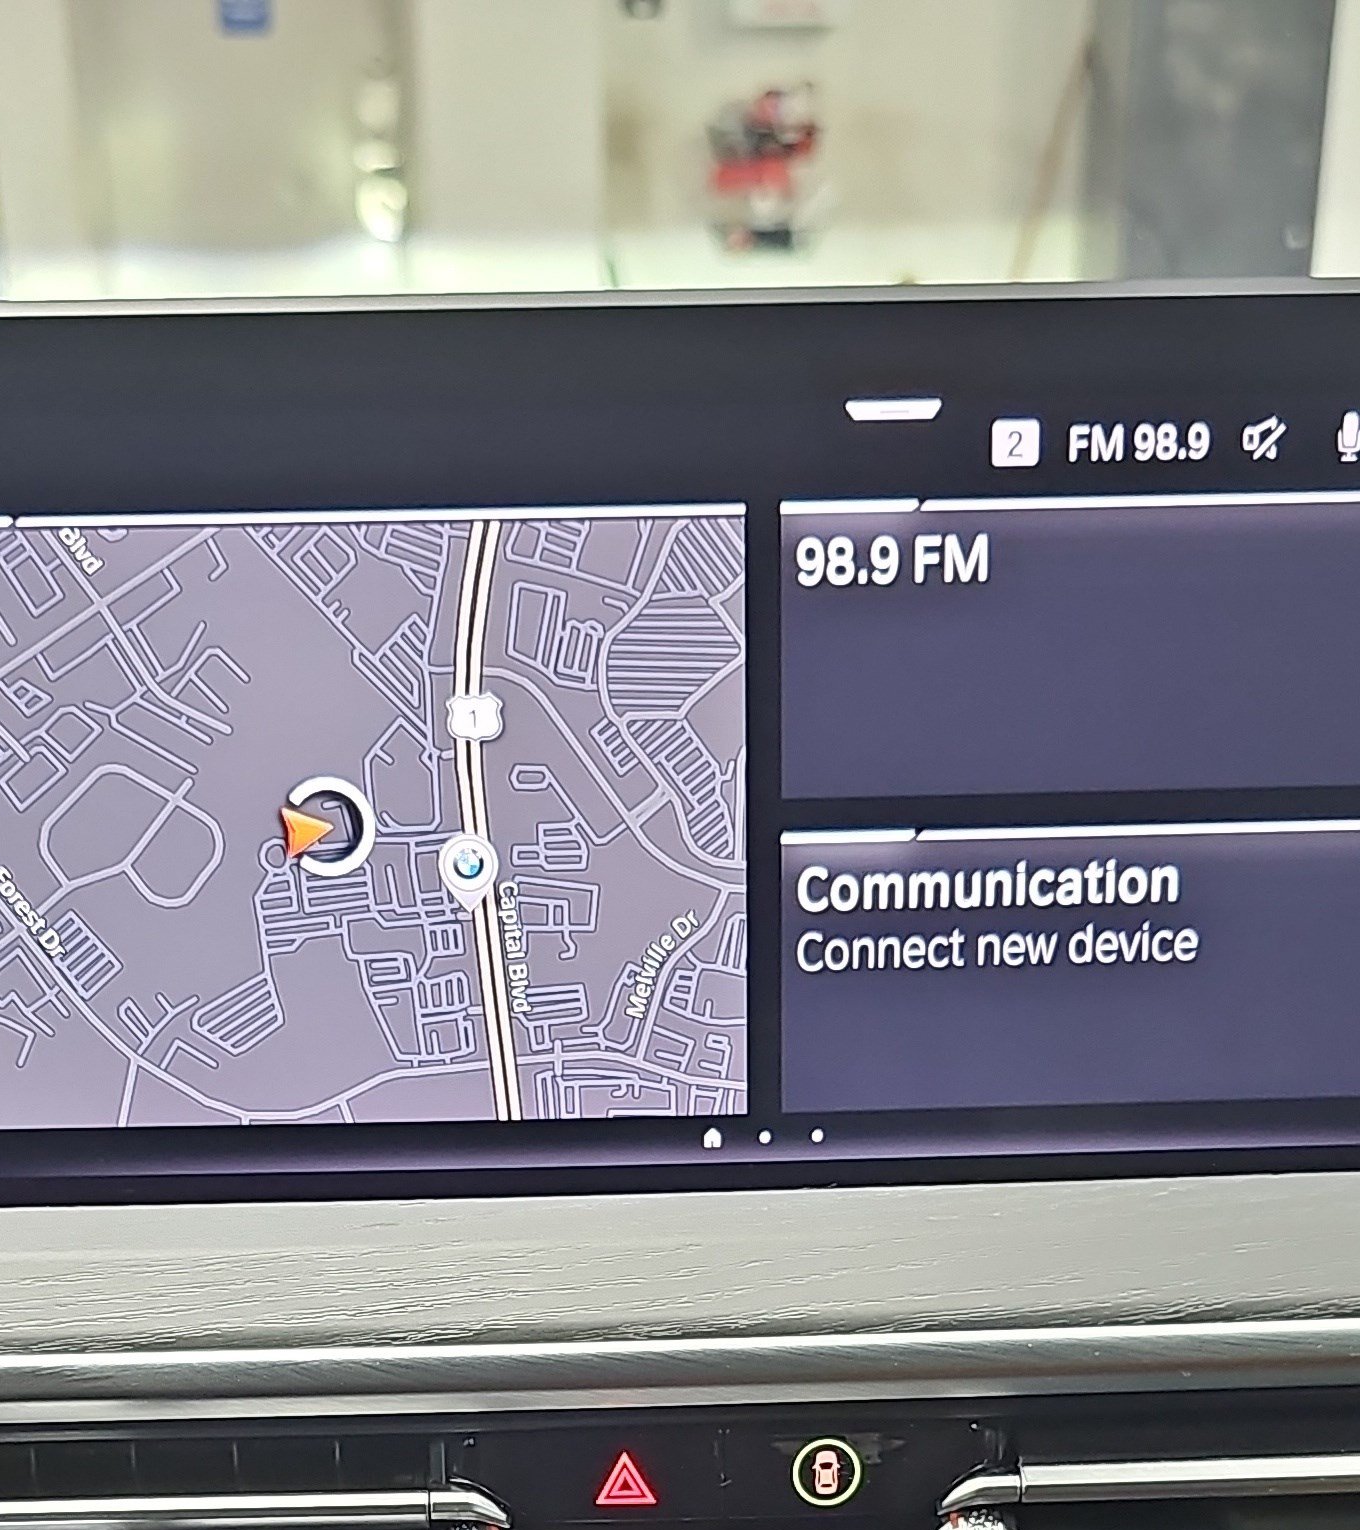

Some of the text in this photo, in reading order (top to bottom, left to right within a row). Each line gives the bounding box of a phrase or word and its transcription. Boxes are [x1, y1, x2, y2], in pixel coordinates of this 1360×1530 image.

[1006, 430, 1024, 458] 2
[1068, 421, 1211, 464] FM 98.9
[58, 527, 105, 576] Blvd
[795, 533, 990, 587] 98.9 FM
[796, 860, 1180, 914] Communication
[39, 927, 67, 957] Dr
[498, 881, 532, 1013] Capital Blvd
[625, 910, 699, 1018] Melville Dr
[796, 921, 1200, 973] Connect new device
